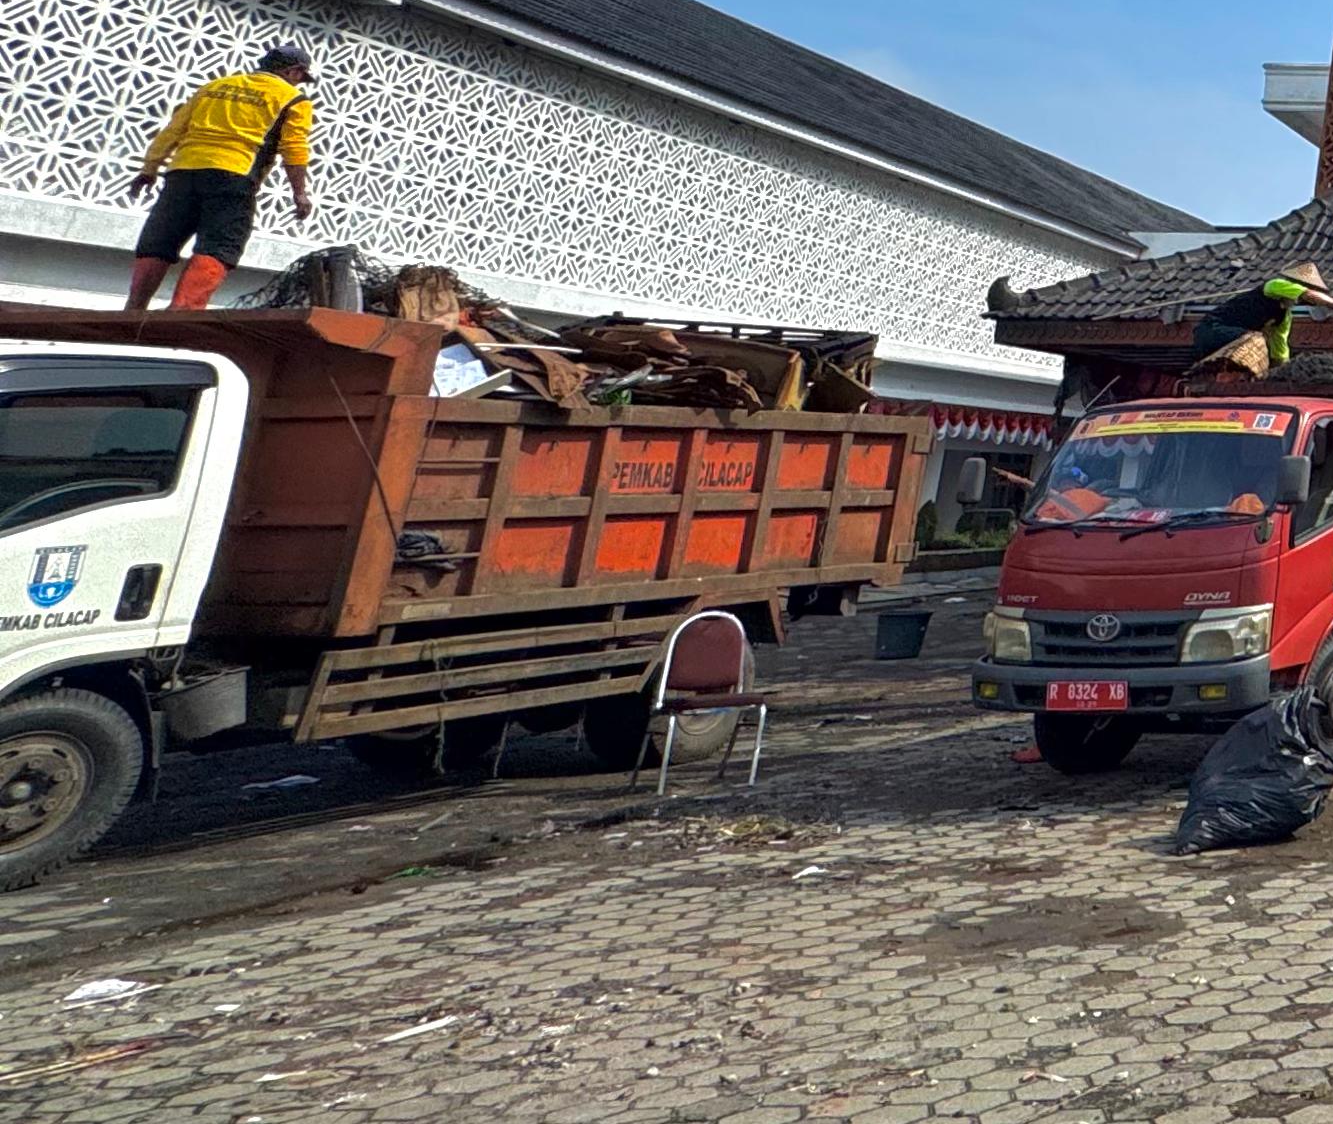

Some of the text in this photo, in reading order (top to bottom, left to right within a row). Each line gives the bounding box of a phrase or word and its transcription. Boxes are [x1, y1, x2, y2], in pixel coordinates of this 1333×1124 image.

[1184, 590, 1231, 601] DYNA
[44, 609, 100, 629] CILACAP
[1050, 683, 1125, 700] R 8324 XB
